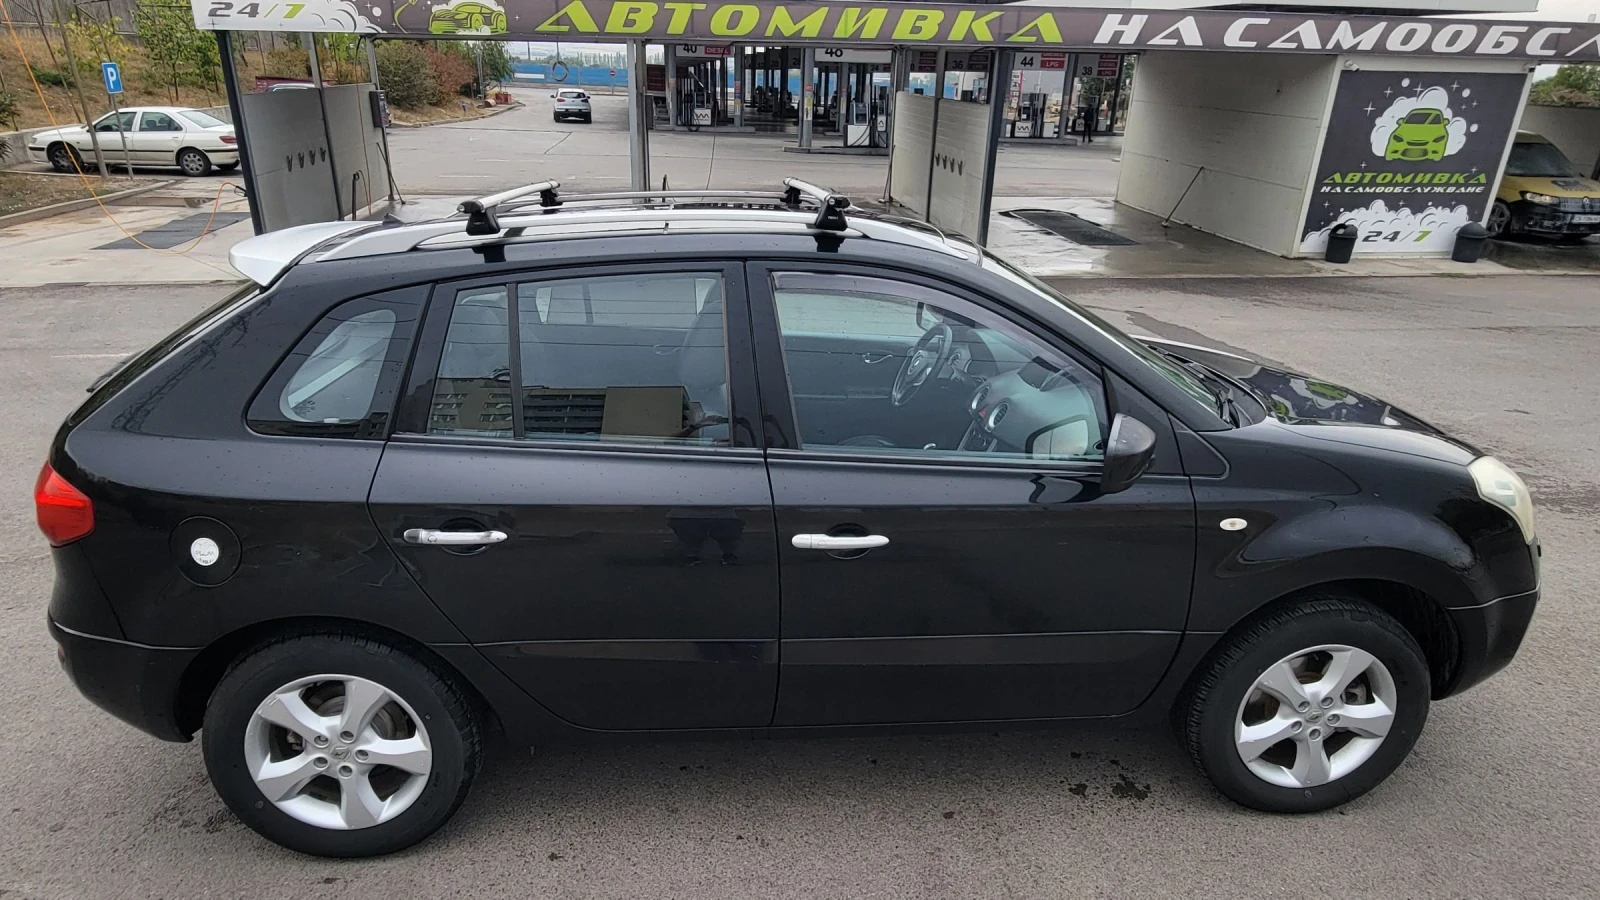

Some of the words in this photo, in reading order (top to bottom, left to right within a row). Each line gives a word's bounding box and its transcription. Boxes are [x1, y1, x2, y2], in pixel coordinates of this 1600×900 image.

[208, 2, 306, 18] 24/7
[535, 1, 1063, 42] АВТОМИВКА
[1093, 14, 1203, 46] НА
[952, 61, 964, 69] 36
[1021, 56, 1034, 67] 44
[1082, 66, 1093, 75] 38
[107, 67, 117, 89] P
[1324, 172, 1487, 184] АВТОМИВКА
[1362, 230, 1432, 242] 24/7
